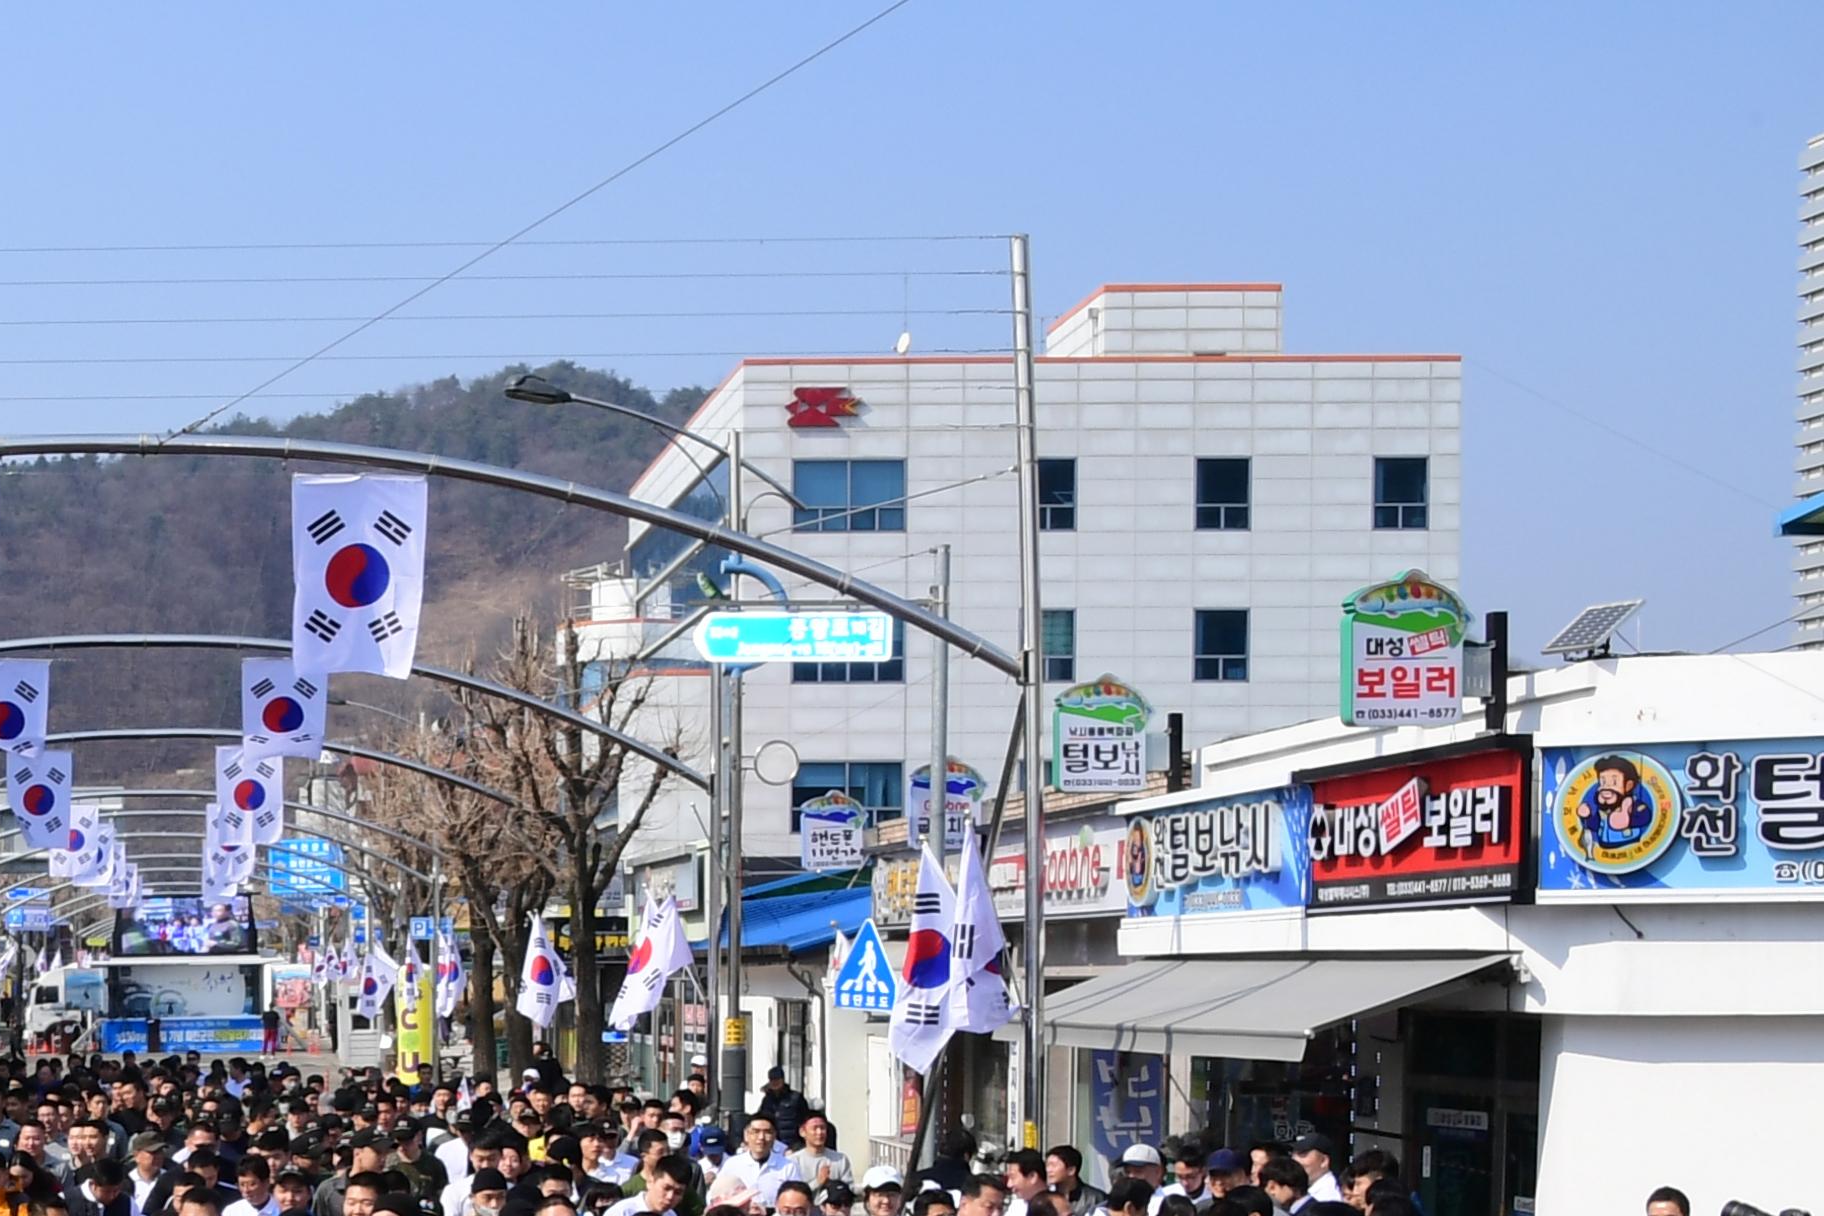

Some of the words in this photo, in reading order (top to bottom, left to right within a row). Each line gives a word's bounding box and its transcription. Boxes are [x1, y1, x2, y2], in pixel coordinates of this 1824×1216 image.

[1366, 636, 1404, 657] 대성
[1356, 665, 1456, 699] 보일러
[1333, 803, 1377, 858] 대성
[1422, 784, 1500, 849] 보일러
[1169, 801, 1270, 883] 털보낚시
[414, 922, 423, 936] P
[839, 992, 889, 1008] 횡단보도
